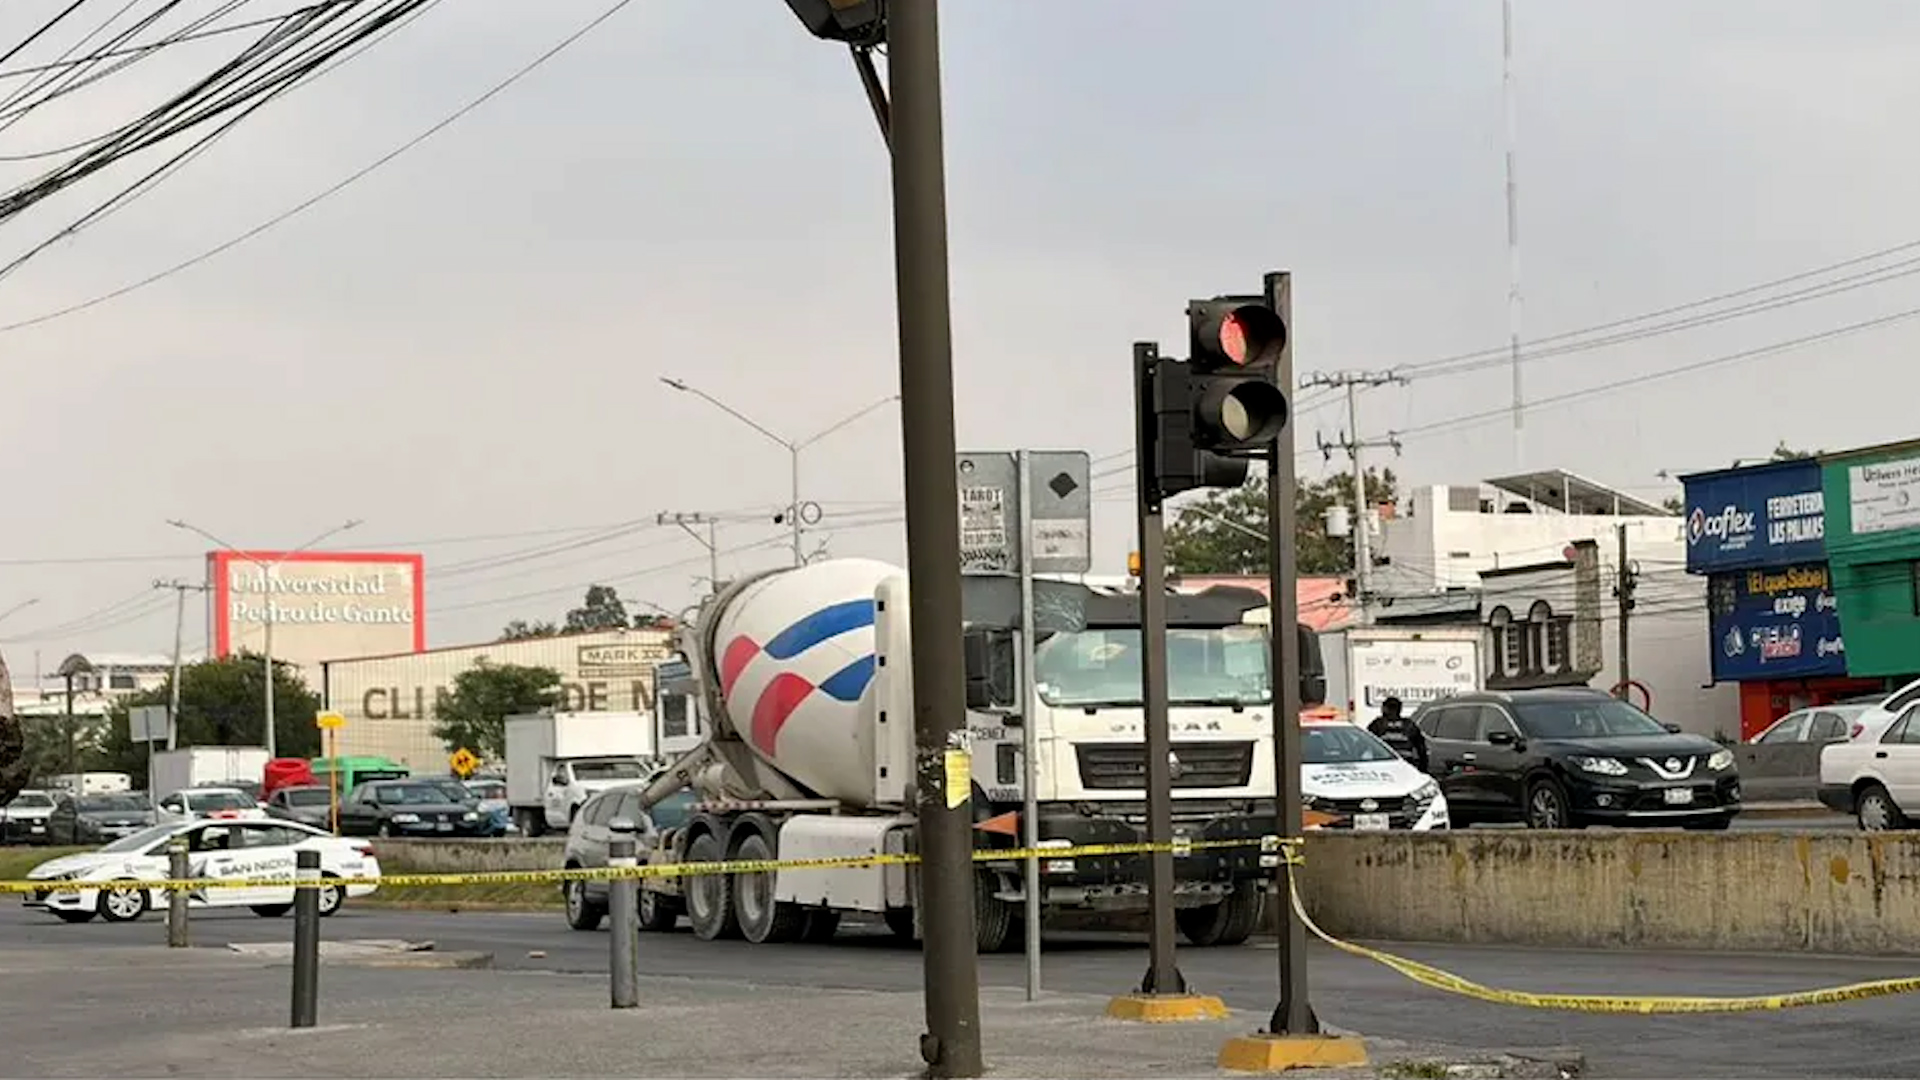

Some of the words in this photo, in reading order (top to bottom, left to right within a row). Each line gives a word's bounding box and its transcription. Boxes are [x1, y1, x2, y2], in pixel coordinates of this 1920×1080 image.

[962, 489, 1000, 501] TAROT
[1704, 505, 1756, 540] coflex
[1769, 521, 1786, 545] LAS
[1786, 515, 1825, 543] PALMAS
[231, 571, 386, 594] Universidad
[231, 601, 305, 623] Pedro
[309, 602, 337, 622] de
[342, 604, 415, 624] Gante
[587, 650, 637, 661] MARK
[561, 682, 608, 711] DE
[219, 863, 252, 877] SAN
[254, 857, 297, 872] NICOL
